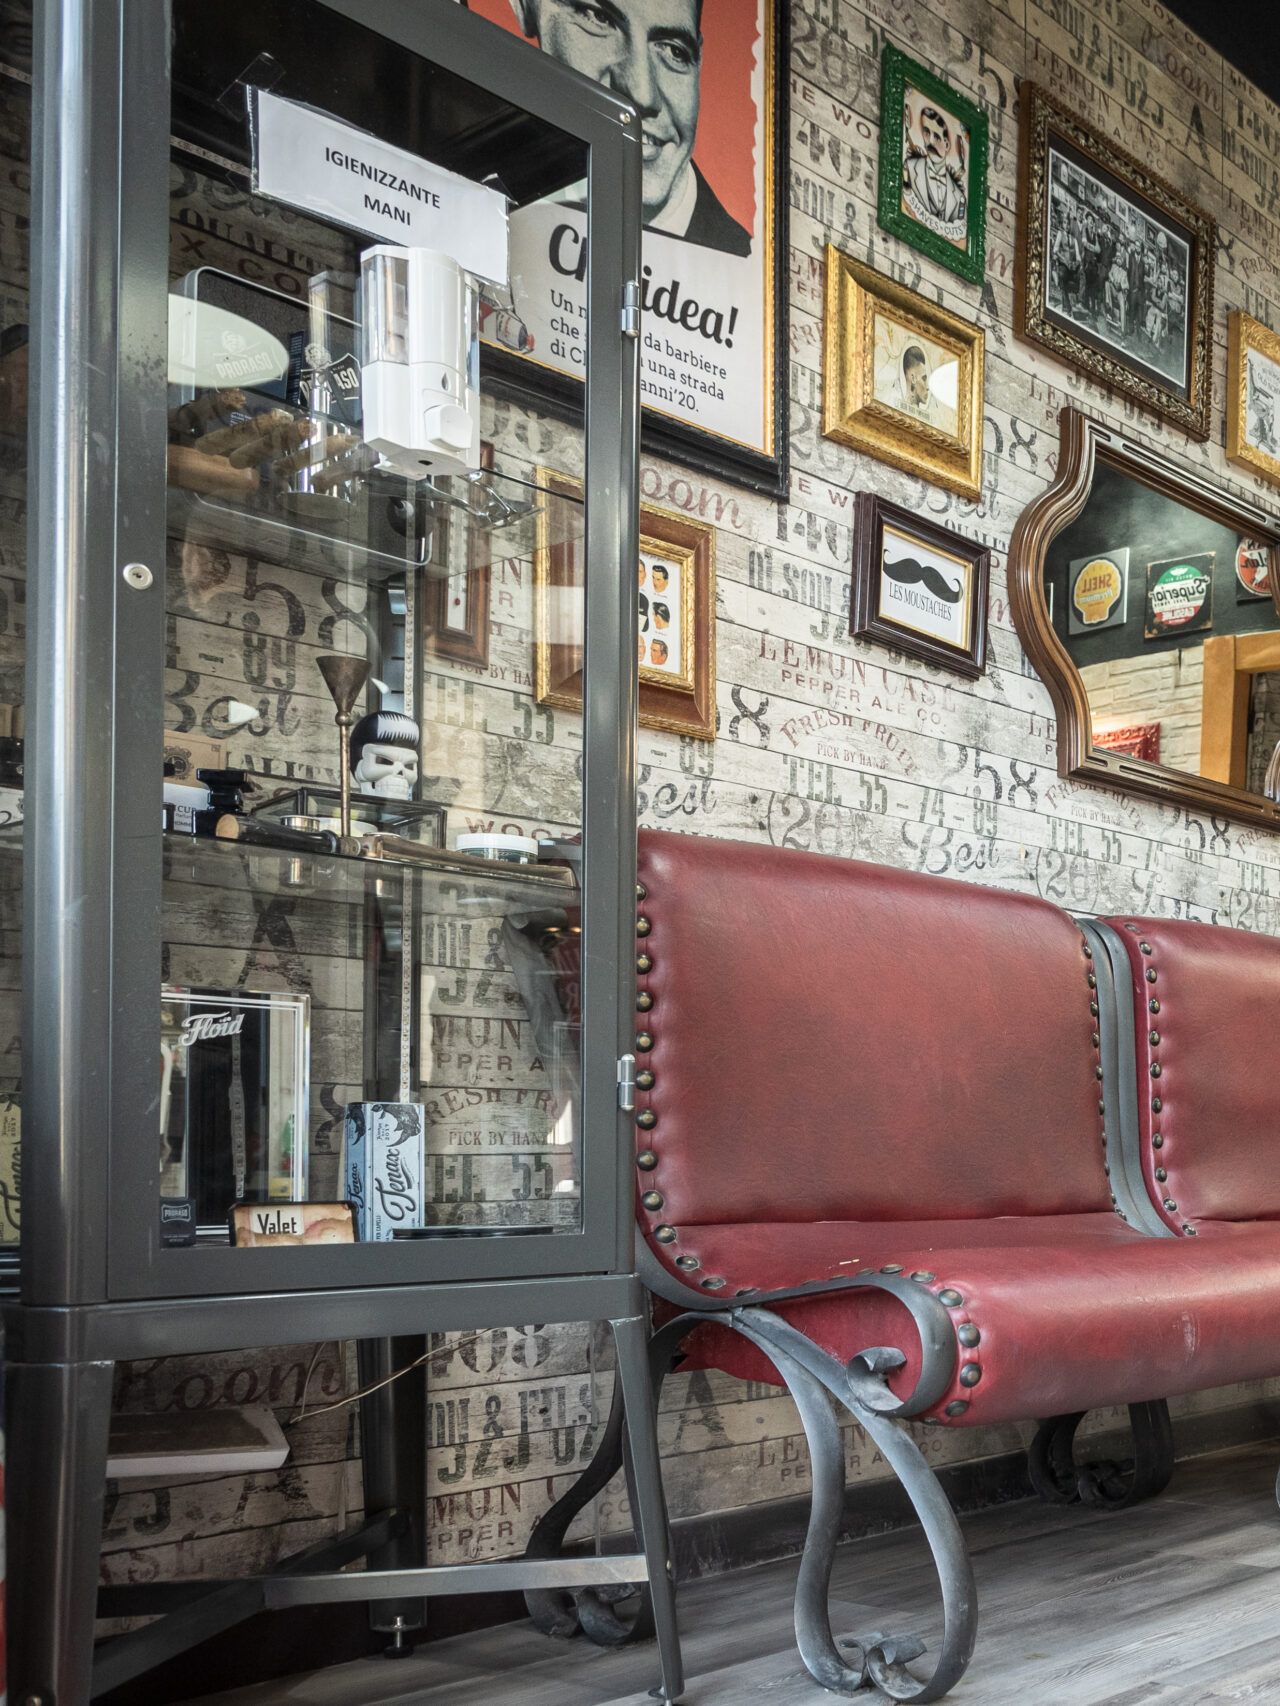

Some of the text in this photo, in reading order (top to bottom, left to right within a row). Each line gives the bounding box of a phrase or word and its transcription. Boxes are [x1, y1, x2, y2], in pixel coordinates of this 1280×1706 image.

[325, 147, 441, 209] IGIENIZZANTE
[364, 194, 411, 226] MANI
[550, 289, 574, 314] Un
[641, 265, 739, 349] idea!
[550, 317, 580, 340] che
[550, 340, 566, 357] di
[644, 333, 727, 380] da barbiere
[648, 359, 725, 401] una strada
[889, 582, 952, 622] LES MOUSTACHES
[758, 630, 868, 690] LEMON
[781, 668, 862, 704] PEPPER
[871, 695, 907, 716] ALE
[780, 710, 919, 777] FRESH FRUIT
[817, 743, 840, 760] PICK
[843, 749, 856, 763] BY
[782, 753, 843, 806] TEL
[859, 772, 889, 815] 55
[375, 1148, 417, 1221] Tenax
[256, 1210, 298, 1235] Valet
